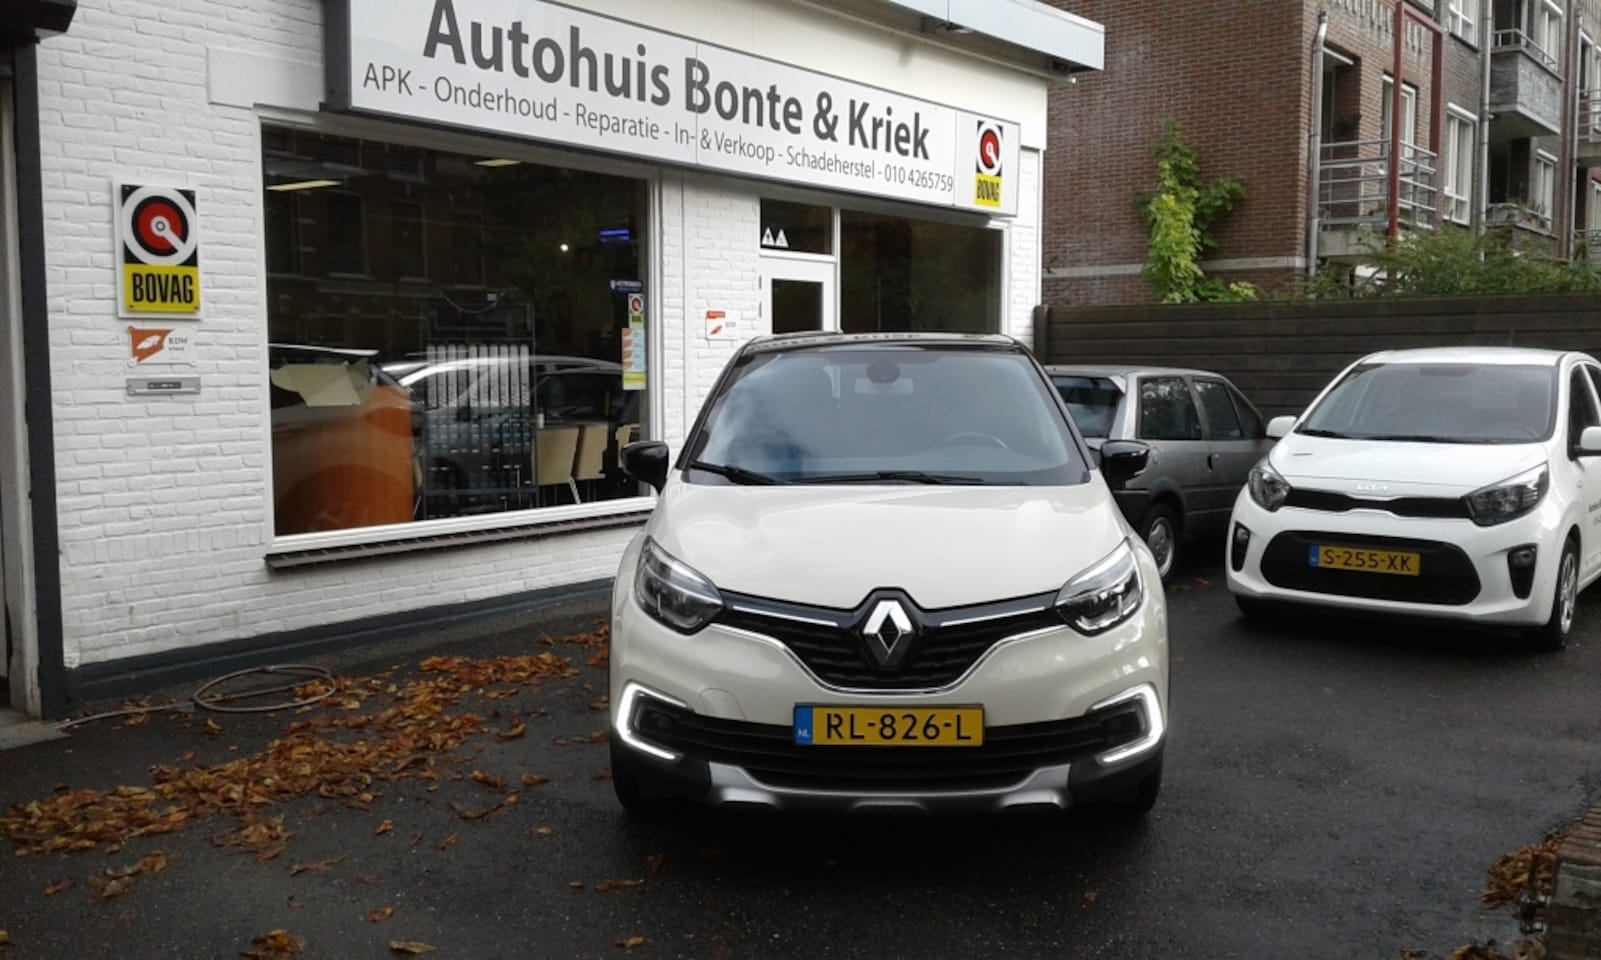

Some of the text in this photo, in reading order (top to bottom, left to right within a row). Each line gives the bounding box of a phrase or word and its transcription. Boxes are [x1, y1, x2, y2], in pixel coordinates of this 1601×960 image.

[423, 0, 930, 161] Autohuis Bonte & Kriek
[363, 63, 413, 96] APK
[434, 76, 558, 121] Onderhoud
[576, 103, 660, 141] Reparatie
[700, 128, 712, 150] &
[713, 130, 775, 166] Verkoop
[786, 145, 875, 180] Schadeherstel
[884, 163, 906, 185] 010
[907, 168, 954, 192] 4265759
[977, 179, 999, 203] BOVAG
[132, 273, 194, 304] BOVAG
[1324, 549, 1412, 571] S-255-XK
[797, 728, 811, 738] NL
[826, 713, 972, 740] RL-826-L
